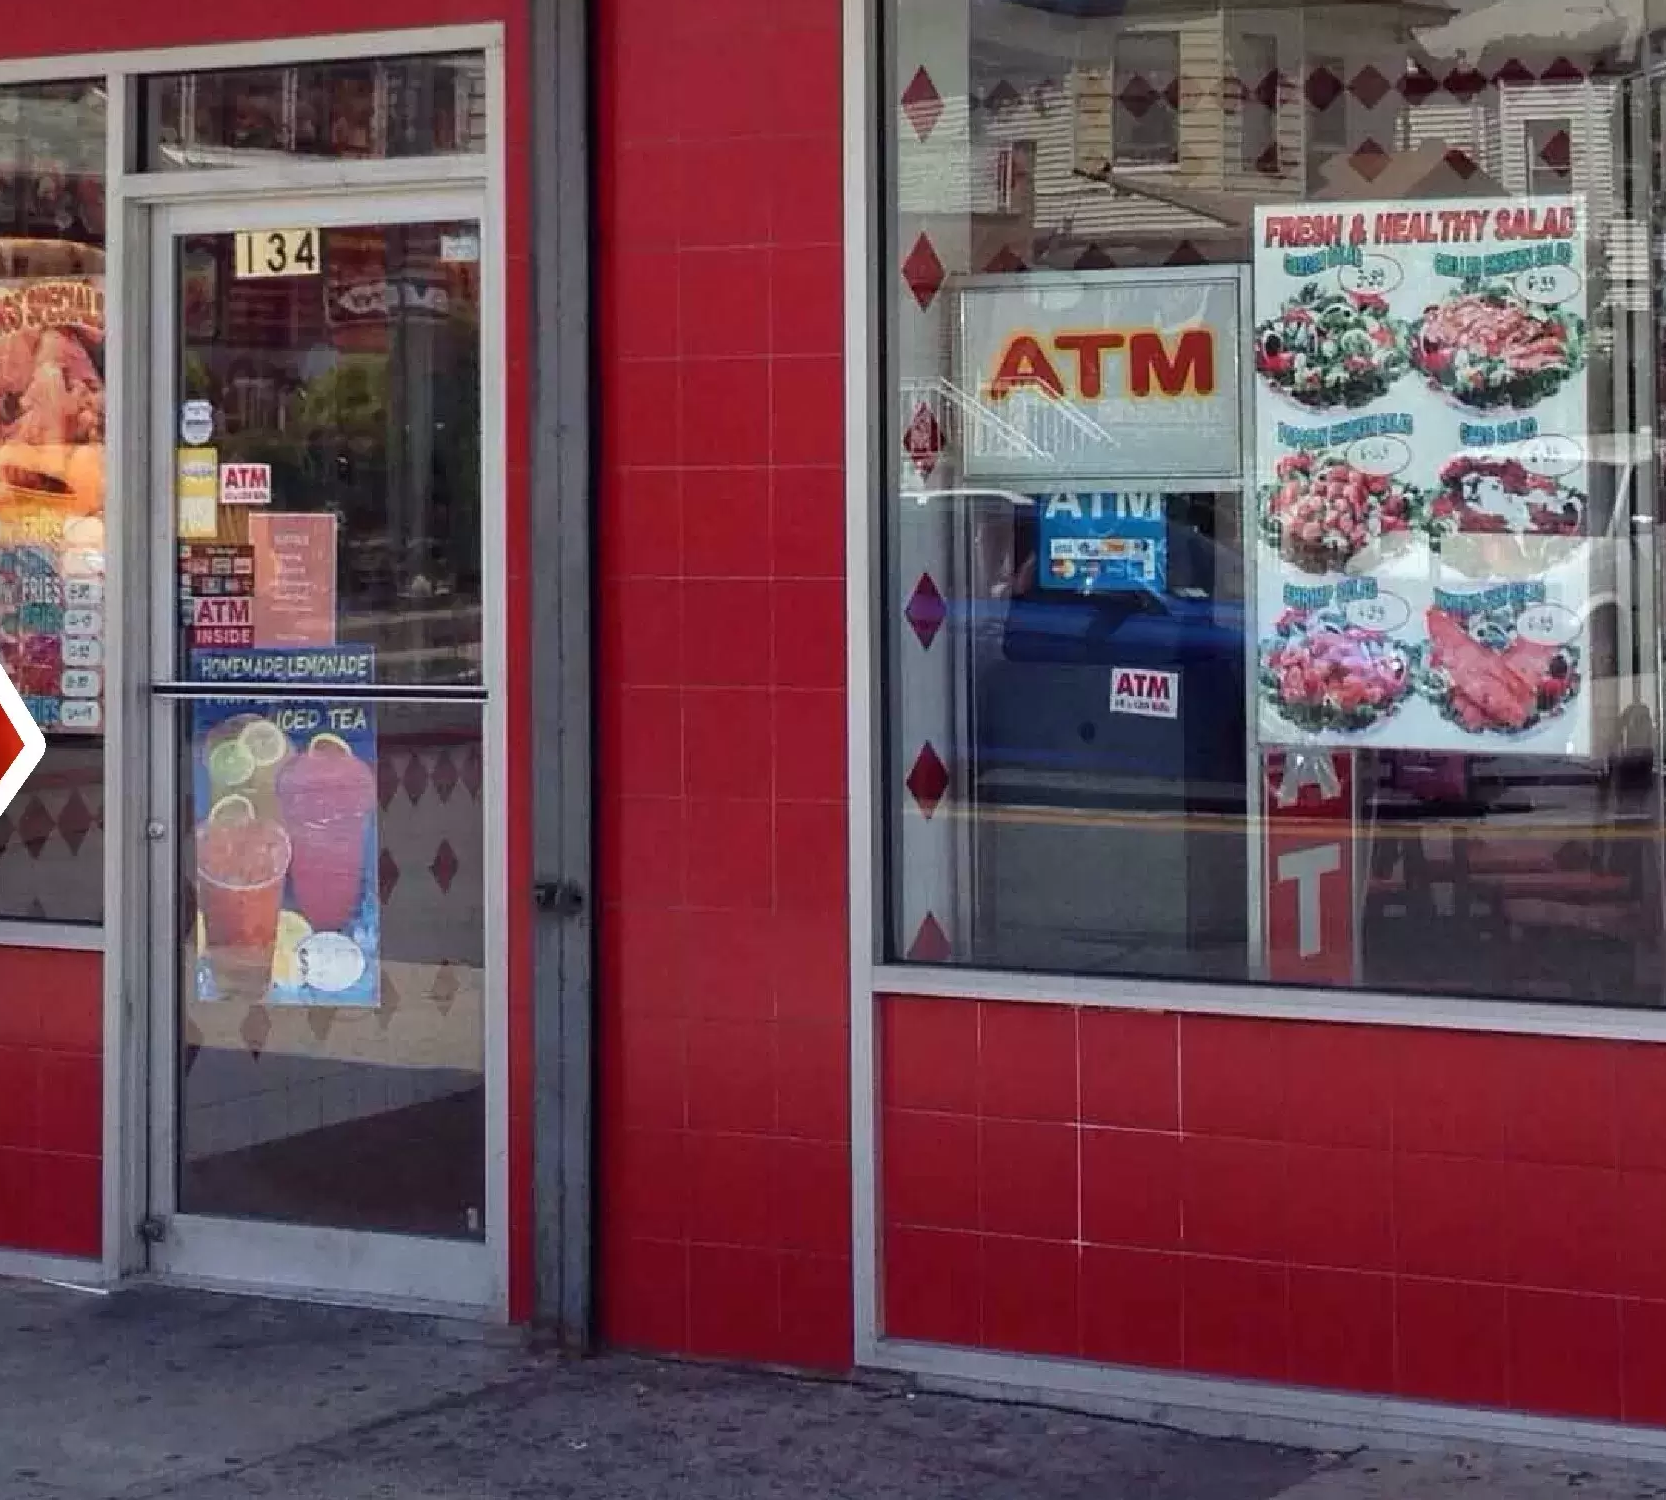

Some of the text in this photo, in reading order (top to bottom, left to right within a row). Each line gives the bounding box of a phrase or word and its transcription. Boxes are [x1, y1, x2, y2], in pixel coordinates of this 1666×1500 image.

[1265, 213, 1344, 248] FRESH
[1349, 213, 1367, 244] &
[1375, 209, 1490, 243] HEALTHY
[247, 230, 316, 274] 134
[991, 329, 1214, 399] ATM
[224, 467, 268, 490] ATM
[196, 600, 250, 624] ATM
[196, 629, 251, 644] INSIDE
[201, 654, 370, 680] HOMEMADE LEMONADE
[1116, 672, 1170, 700] ATM
[276, 707, 367, 730] ICED TEA
